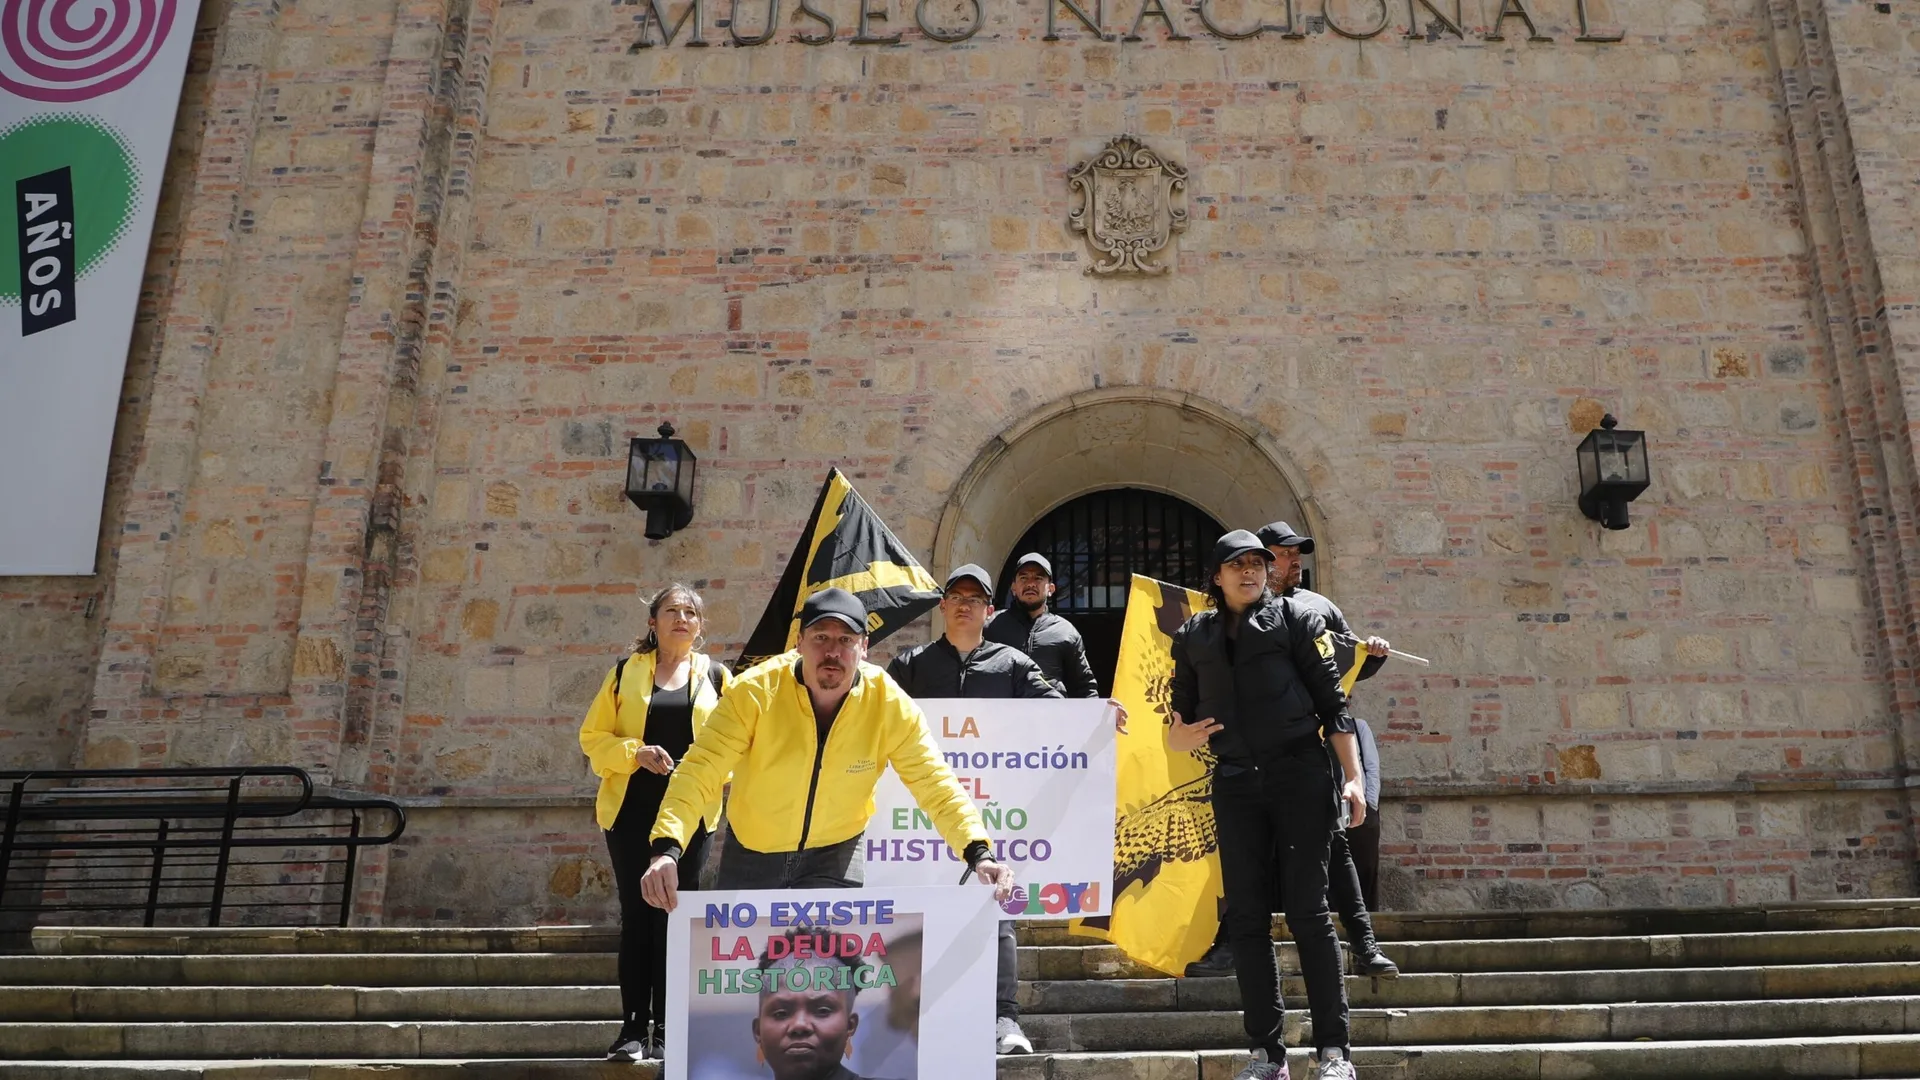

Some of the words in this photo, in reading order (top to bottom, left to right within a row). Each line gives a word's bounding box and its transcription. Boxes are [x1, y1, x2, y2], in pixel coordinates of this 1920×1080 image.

[631, 0, 987, 48] MUSEO
[1041, 0, 1625, 43] NACIONAL
[24, 193, 72, 316] AÑOS
[942, 716, 981, 738] LA
[944, 745, 1088, 769] moración
[892, 802, 1028, 830] ENÑO
[867, 839, 1052, 862] HISTICO
[704, 902, 758, 928] NO
[770, 900, 894, 927] EXISTE
[711, 936, 755, 961] LA
[767, 932, 888, 960] DEUDA
[698, 960, 897, 994] HISTÓRICA
